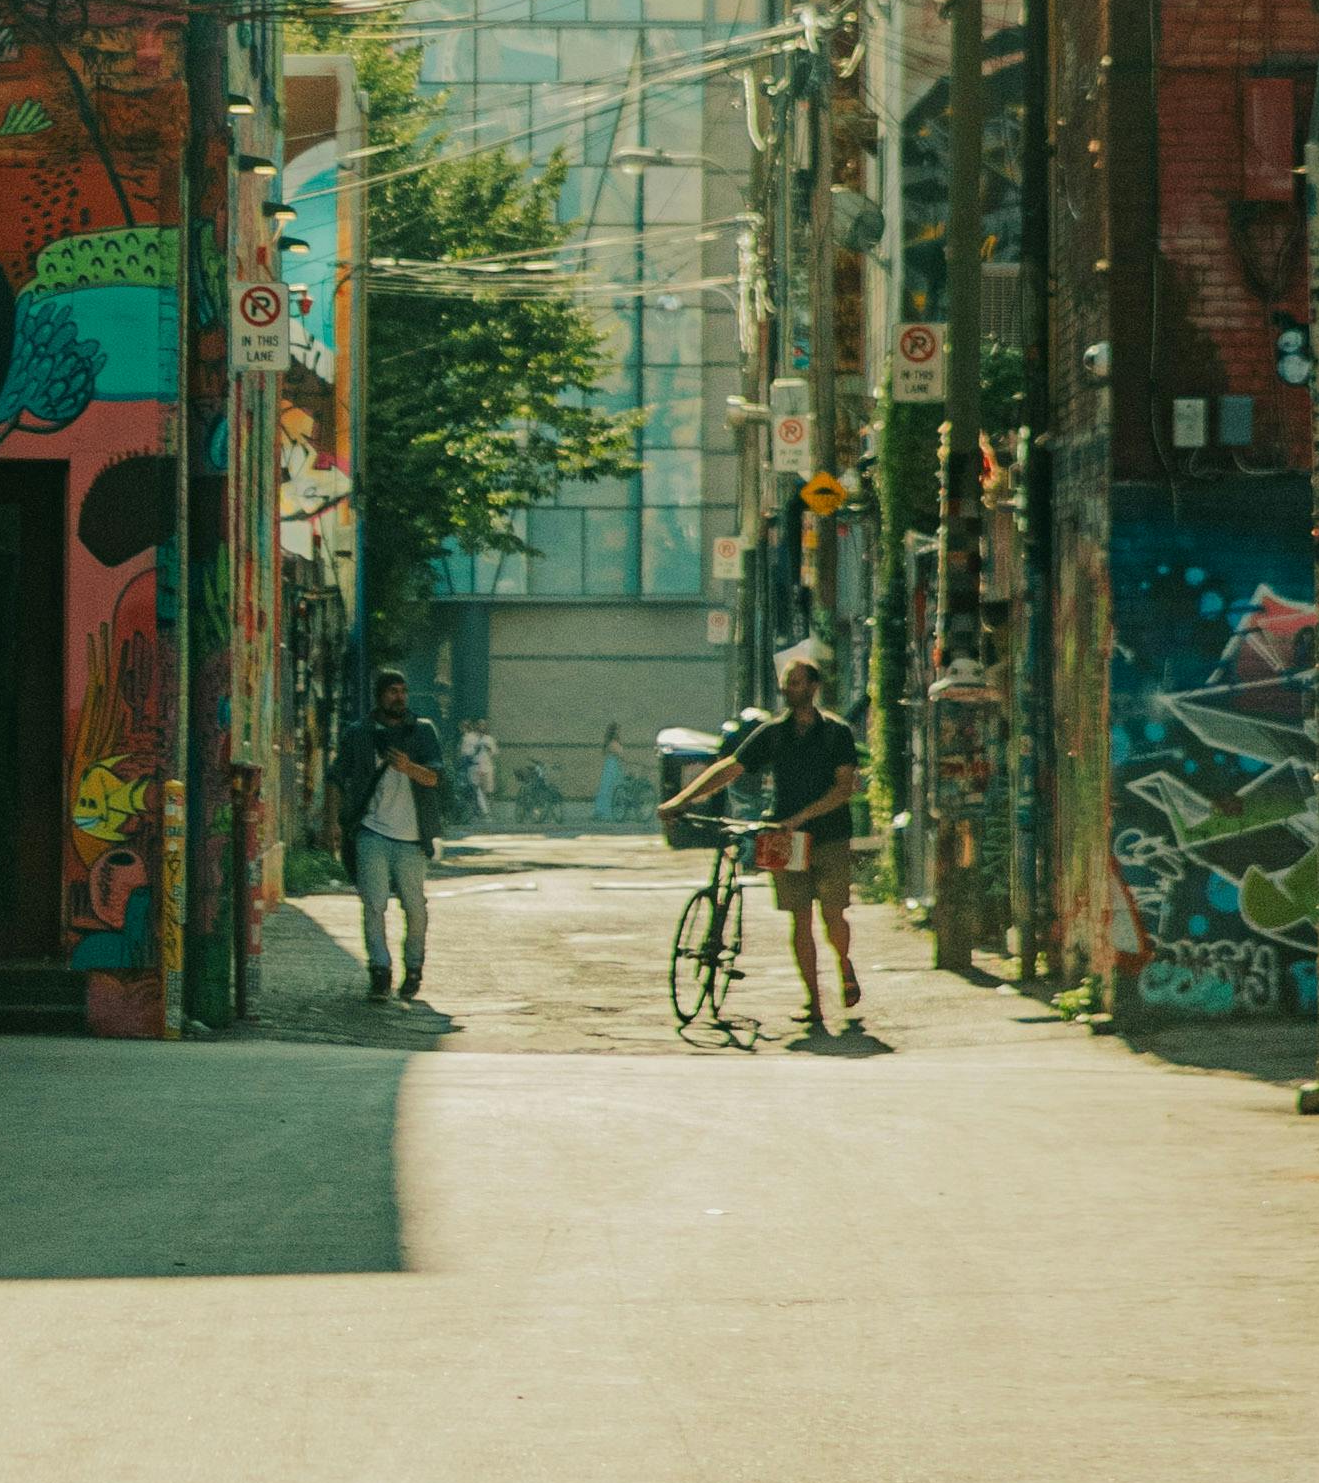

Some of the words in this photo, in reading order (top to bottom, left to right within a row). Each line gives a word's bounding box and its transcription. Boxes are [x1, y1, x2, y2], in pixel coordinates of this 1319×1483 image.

[241, 335, 251, 346] IN
[257, 335, 279, 347] THIS
[247, 350, 273, 362] LANE
